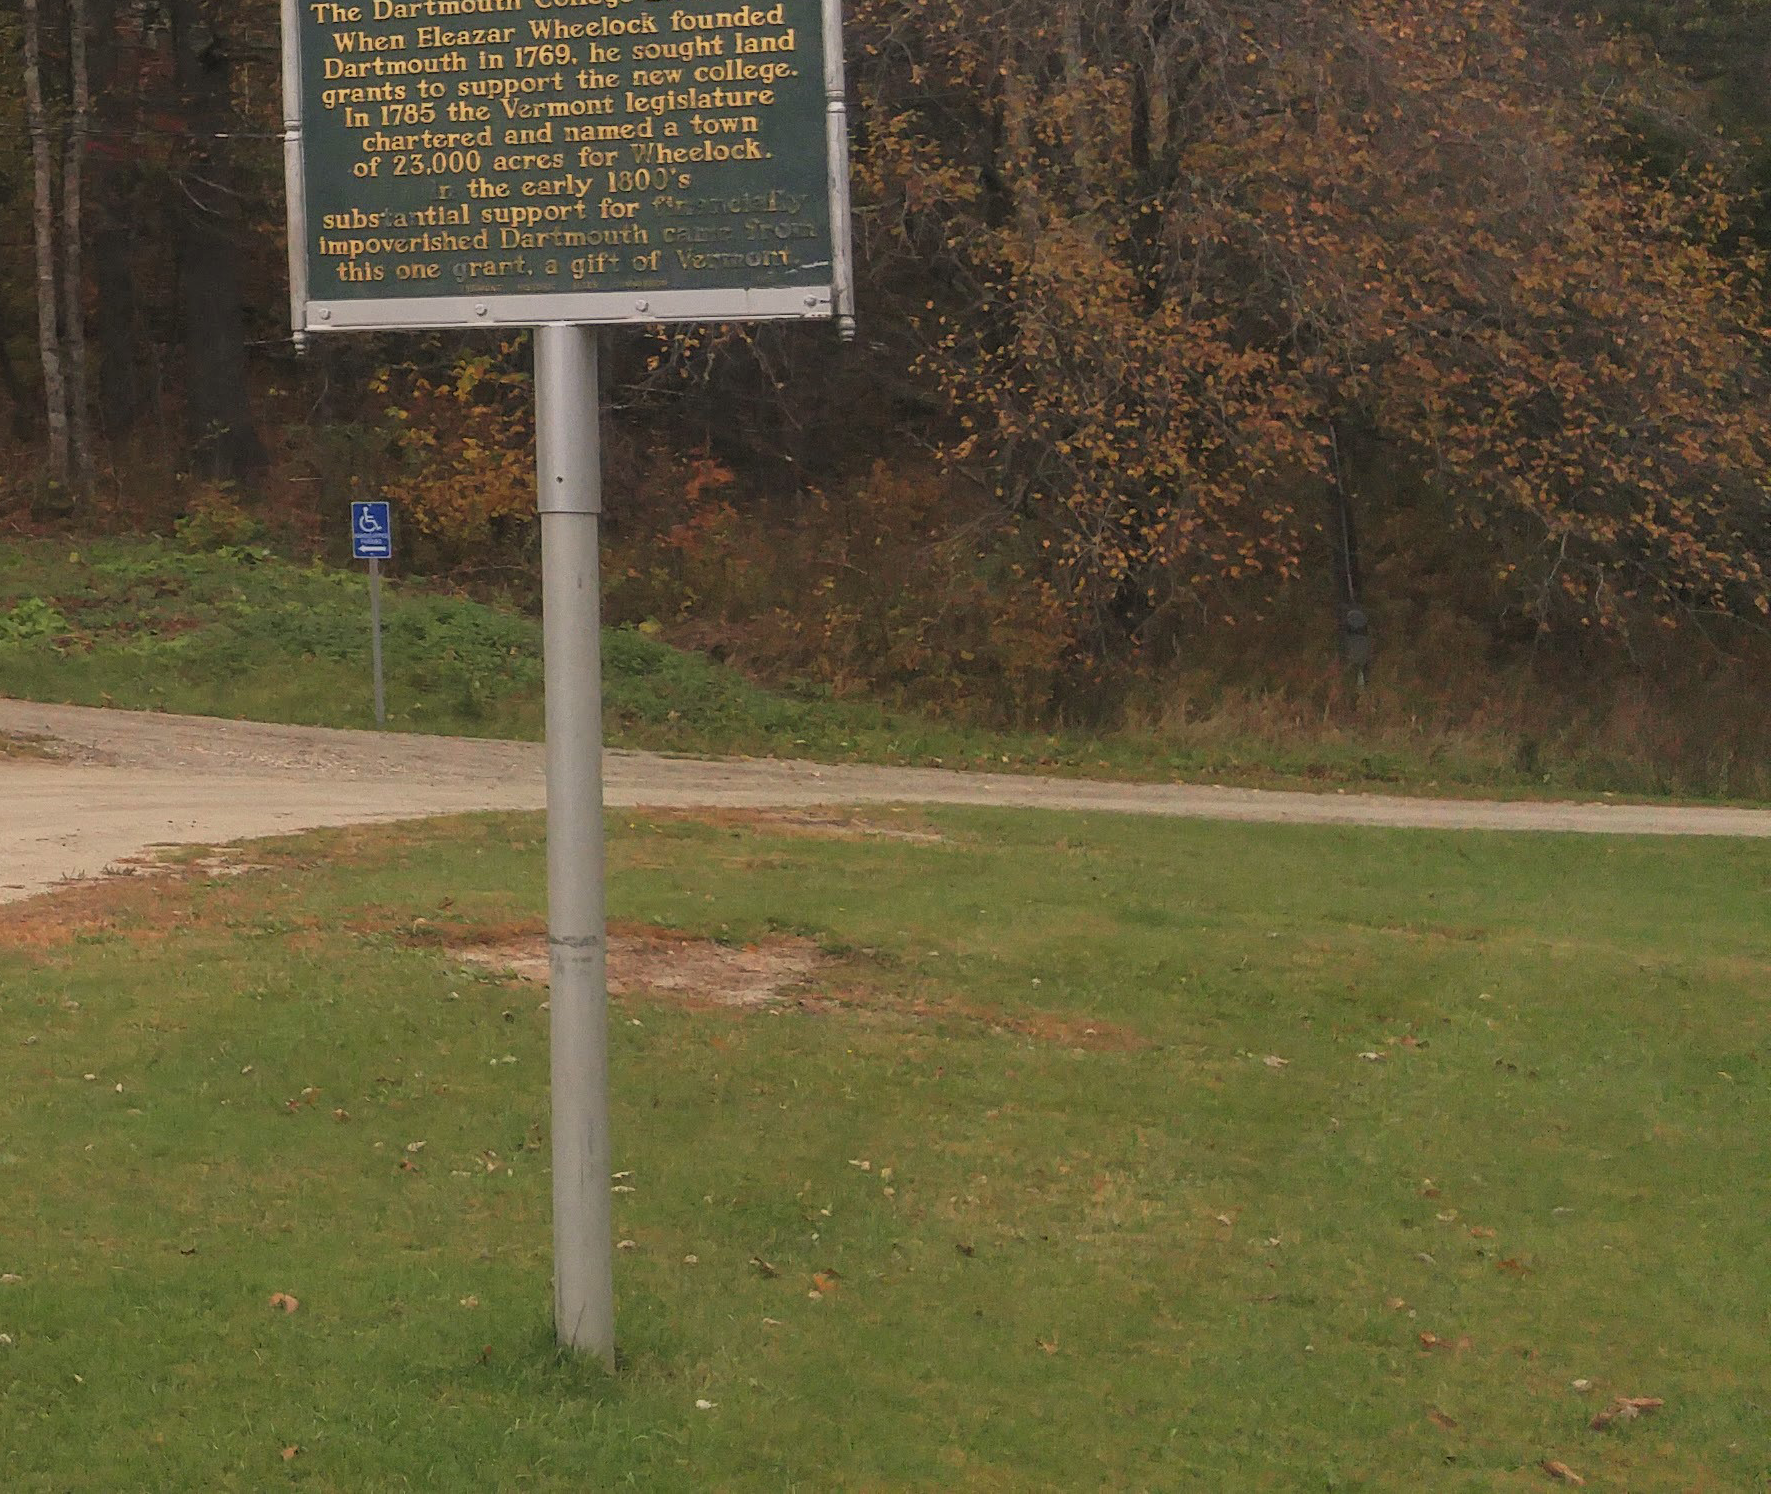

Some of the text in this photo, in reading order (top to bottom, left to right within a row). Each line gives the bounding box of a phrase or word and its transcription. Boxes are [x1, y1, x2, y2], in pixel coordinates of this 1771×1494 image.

[309, 2, 363, 25] The
[331, 3, 786, 54] When Eleazar Wheelock founded
[322, 50, 469, 81] Dartmouth
[478, 50, 505, 71] in
[588, 41, 622, 64] he
[631, 33, 725, 62] sought
[735, 28, 797, 55] land
[321, 58, 800, 110] grants to support the new college.
[344, 87, 776, 129] In 1785 the Vermont legislature
[361, 113, 759, 153] chartered and named a town
[352, 137, 773, 178] of 23,000 acres for Wheelock.
[465, 176, 511, 199] the
[520, 172, 594, 198] early
[480, 198, 586, 228] support
[598, 196, 641, 220] for
[318, 228, 490, 259] impoverished
[499, 222, 649, 251] Dartmouth
[335, 259, 386, 283] this
[395, 261, 443, 281] one
[543, 258, 560, 276] a
[569, 250, 620, 280] gift
[631, 249, 663, 273] of
